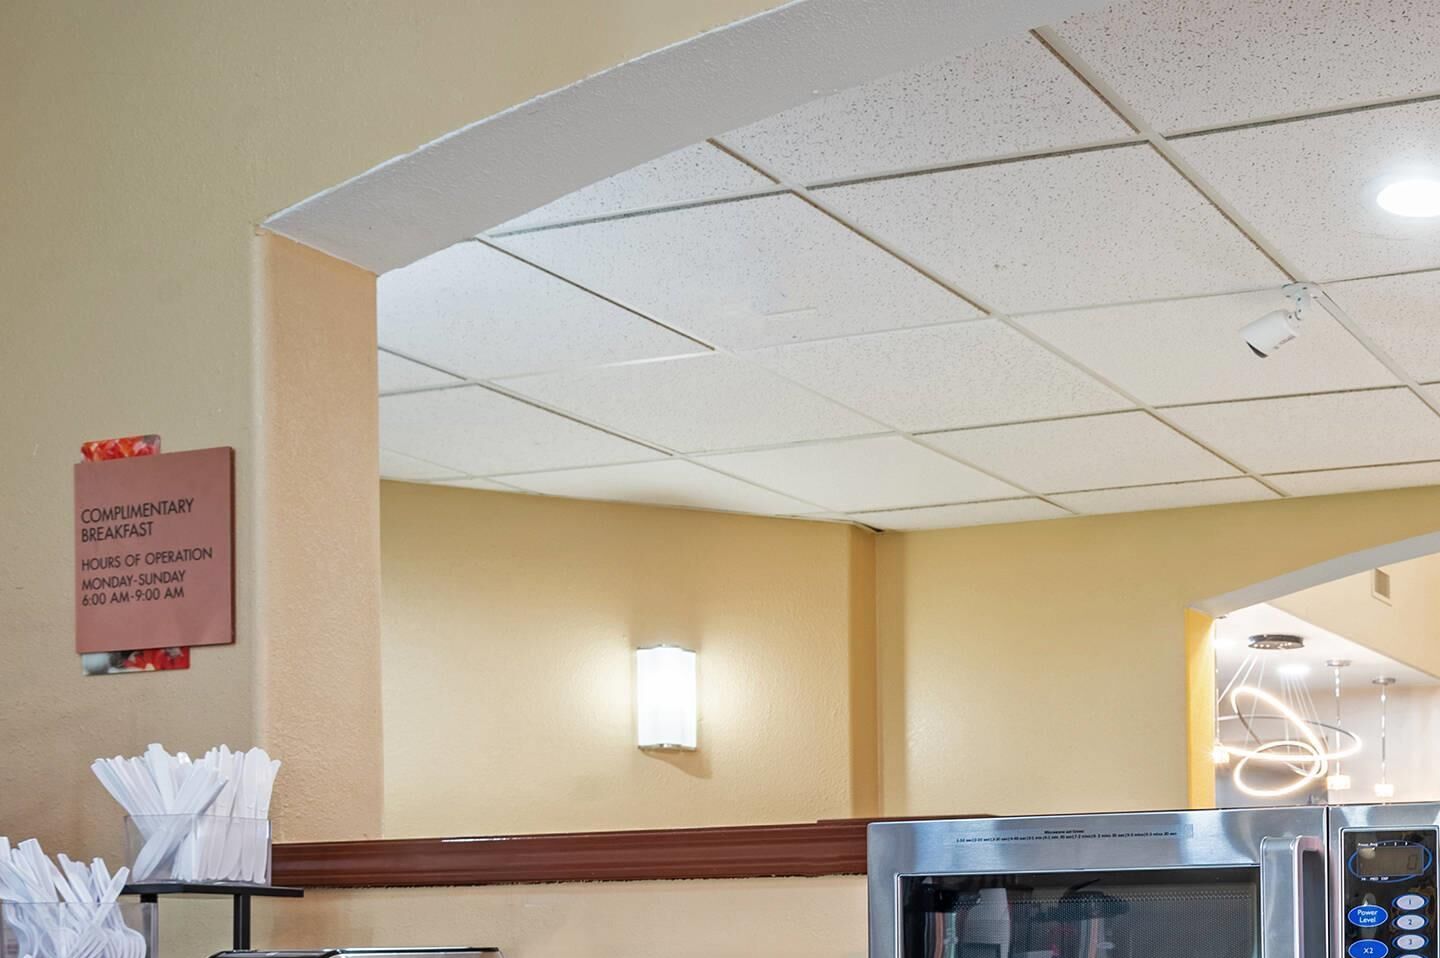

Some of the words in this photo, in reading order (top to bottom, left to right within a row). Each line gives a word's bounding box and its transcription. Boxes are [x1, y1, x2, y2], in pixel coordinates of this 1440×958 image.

[81, 498, 194, 524] COMPLIMENTARY
[81, 521, 154, 543] BREAKFAST
[81, 556, 121, 571] HOURS
[124, 553, 141, 567] OF
[145, 547, 213, 566] OPERATION
[81, 570, 186, 591] MONDAY-SUNDAY
[82, 592, 106, 607] 6:00
[164, 586, 185, 599] AM
